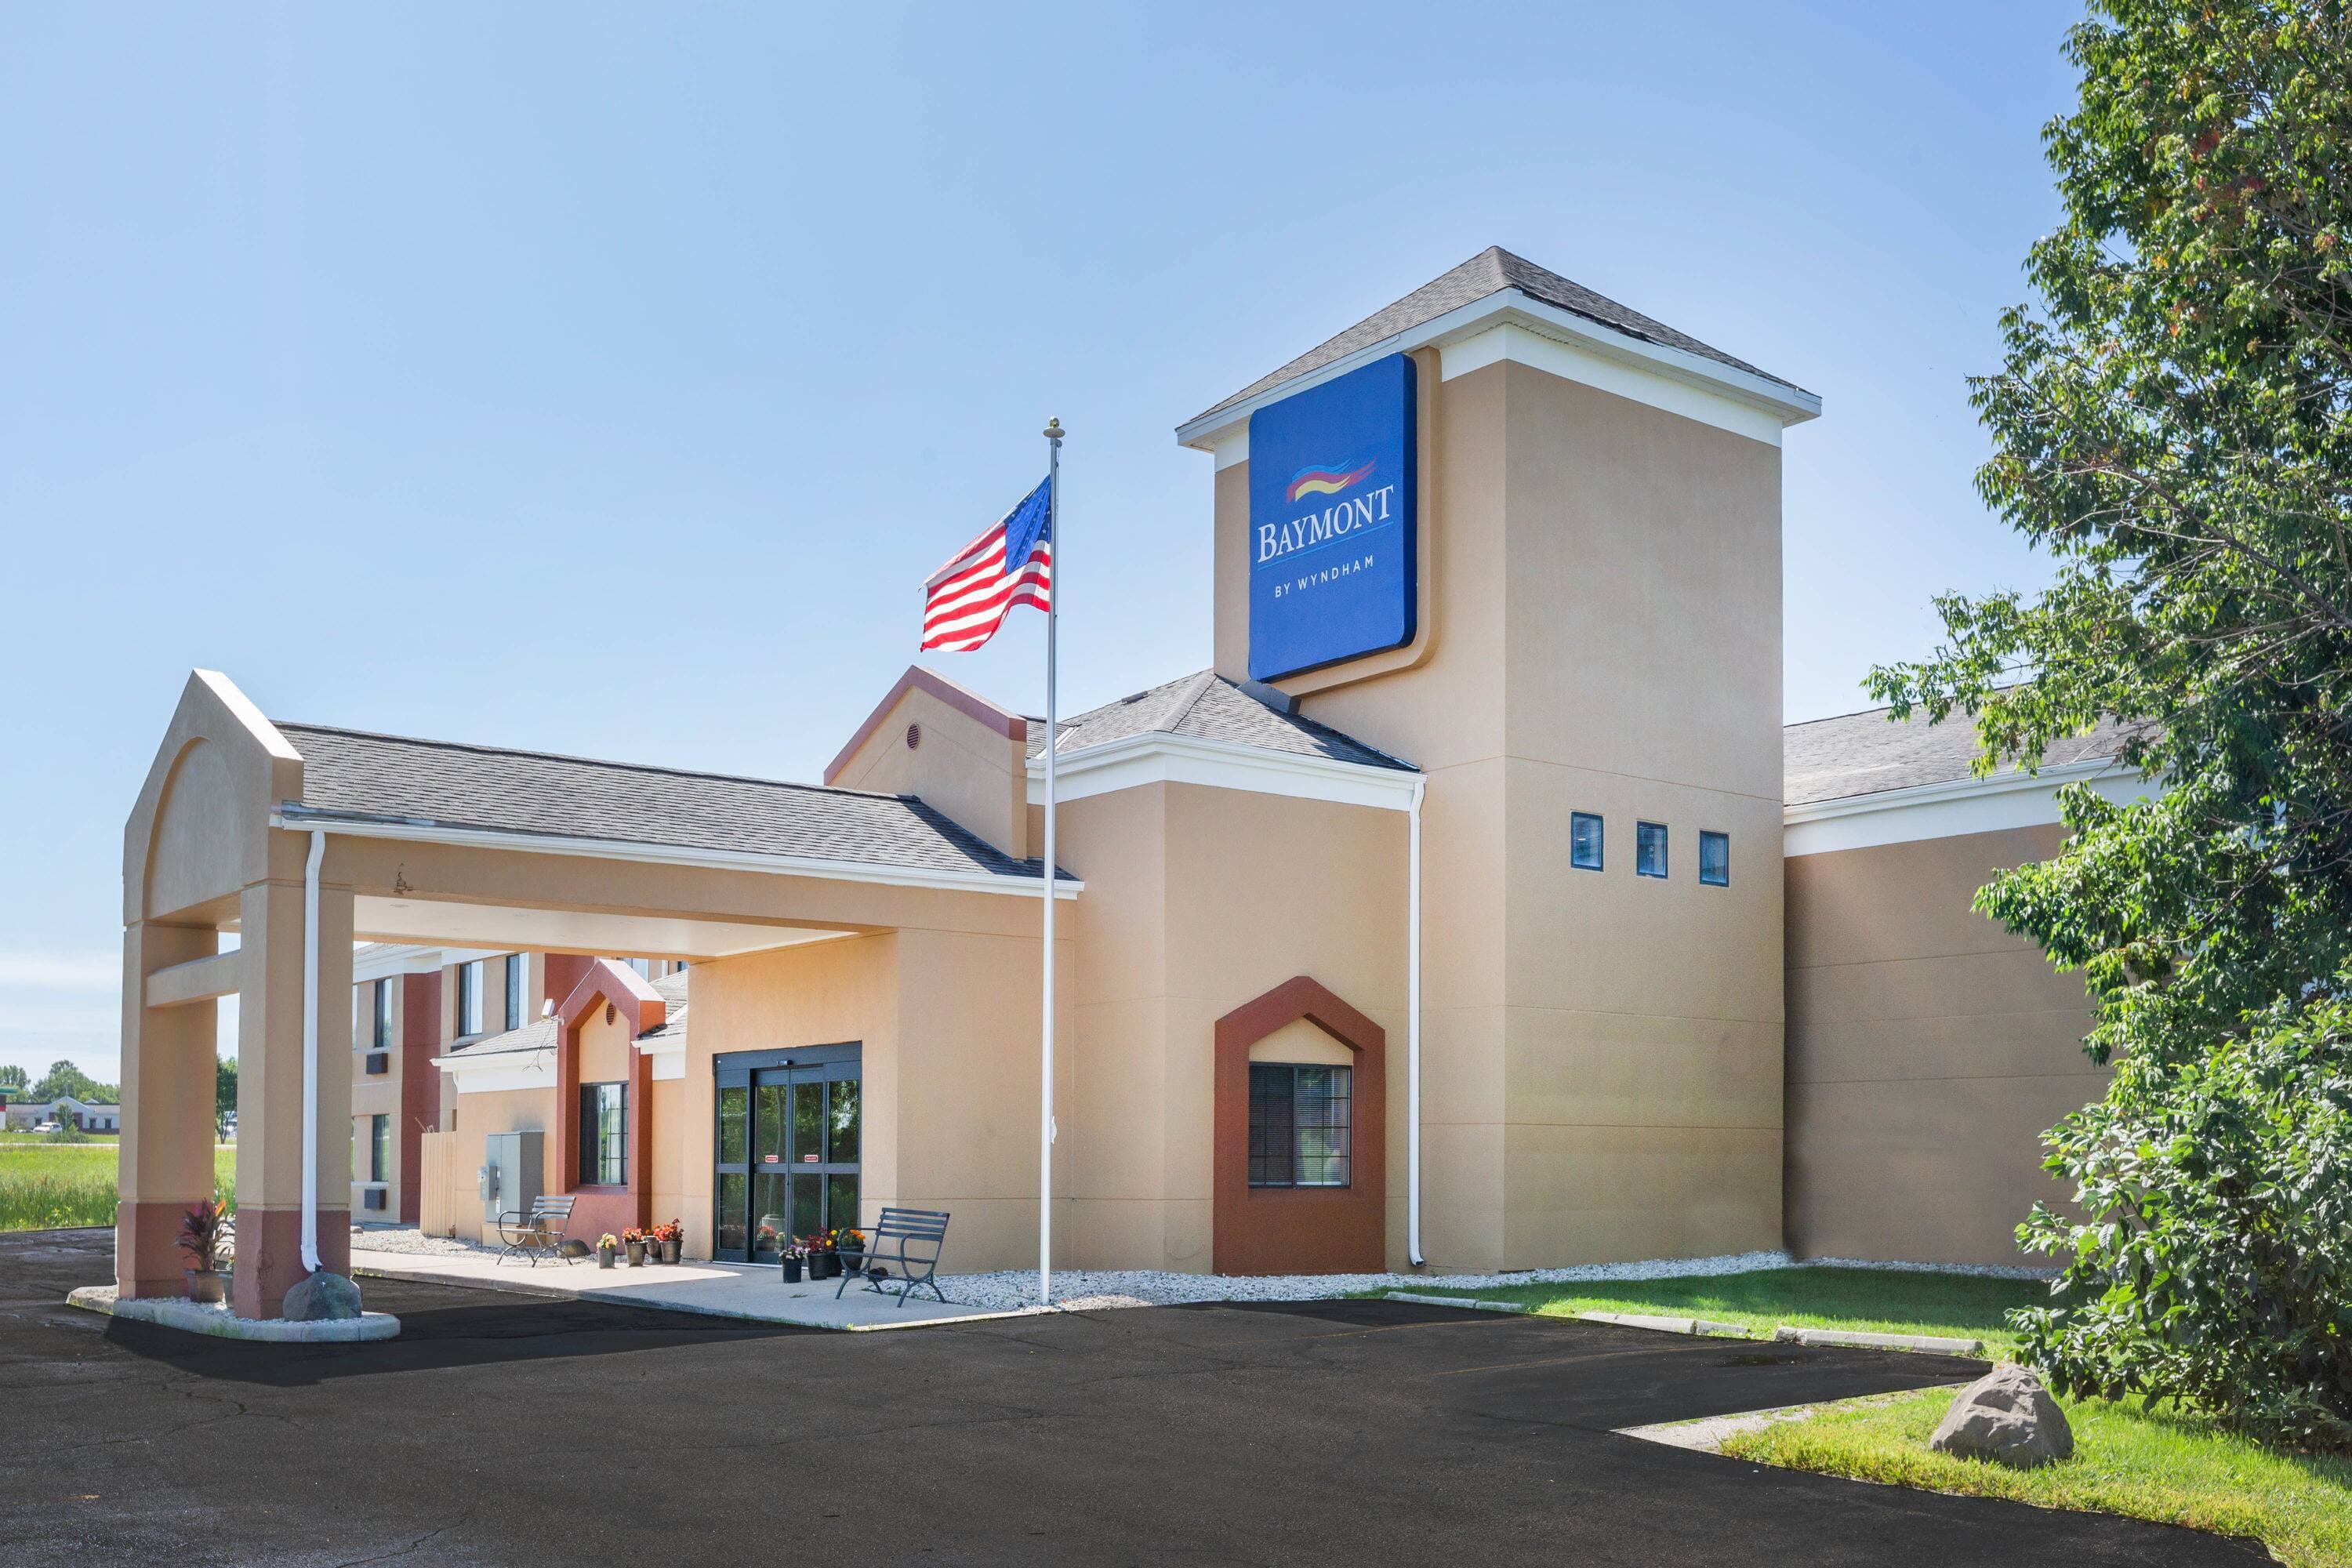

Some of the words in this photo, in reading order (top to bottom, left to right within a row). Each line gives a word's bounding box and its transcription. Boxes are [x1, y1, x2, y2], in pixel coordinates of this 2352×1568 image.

[1258, 484, 1393, 563] BAYMONT
[1275, 583, 1290, 597] BY
[1298, 555, 1373, 590] WYNDHAM
